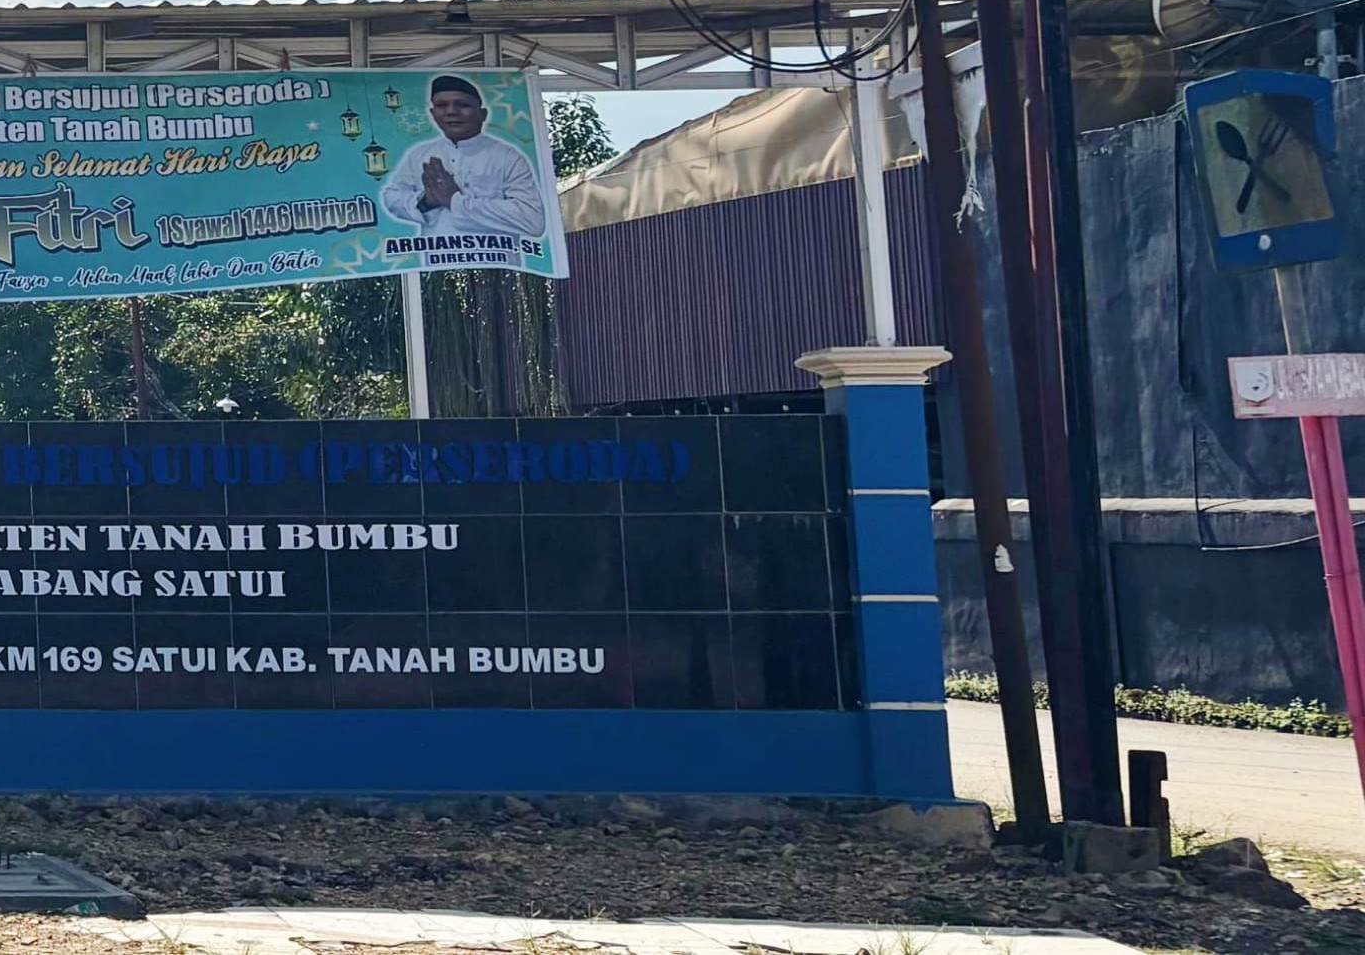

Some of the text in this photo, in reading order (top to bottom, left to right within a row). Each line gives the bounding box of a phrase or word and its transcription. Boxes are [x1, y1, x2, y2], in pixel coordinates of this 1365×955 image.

[3, 84, 139, 113] Bersujud
[146, 79, 312, 109] (Perseroda
[50, 115, 141, 142] Tanah
[146, 113, 254, 141] Bumbu
[31, 150, 152, 178] Selamat
[155, 147, 231, 176] Hari
[234, 140, 320, 173] Raya
[155, 216, 170, 246] 1
[169, 209, 243, 246] Syawal
[242, 203, 294, 239] 1446
[292, 195, 377, 233] Hijriyah
[385, 235, 544, 257] ARDIANSYAH, SE
[429, 252, 508, 265] DIREKTUR
[68, 267, 122, 288] Mohon
[125, 265, 176, 286] Maaf
[180, 261, 224, 284] Lahir
[228, 257, 265, 278] Dan
[269, 249, 322, 275] Batin
[4, 443, 289, 488] BERSUJUD
[298, 440, 693, 485] (PERSERODA)
[99, 524, 267, 551] TANAH
[277, 523, 461, 551] BUMBU
[154, 569, 287, 597] SATUI
[42, 646, 103, 672] 169
[112, 646, 217, 673] SATUI
[226, 646, 317, 673] KAB.
[327, 647, 456, 673] TANAH
[468, 647, 605, 674] BUMBU
